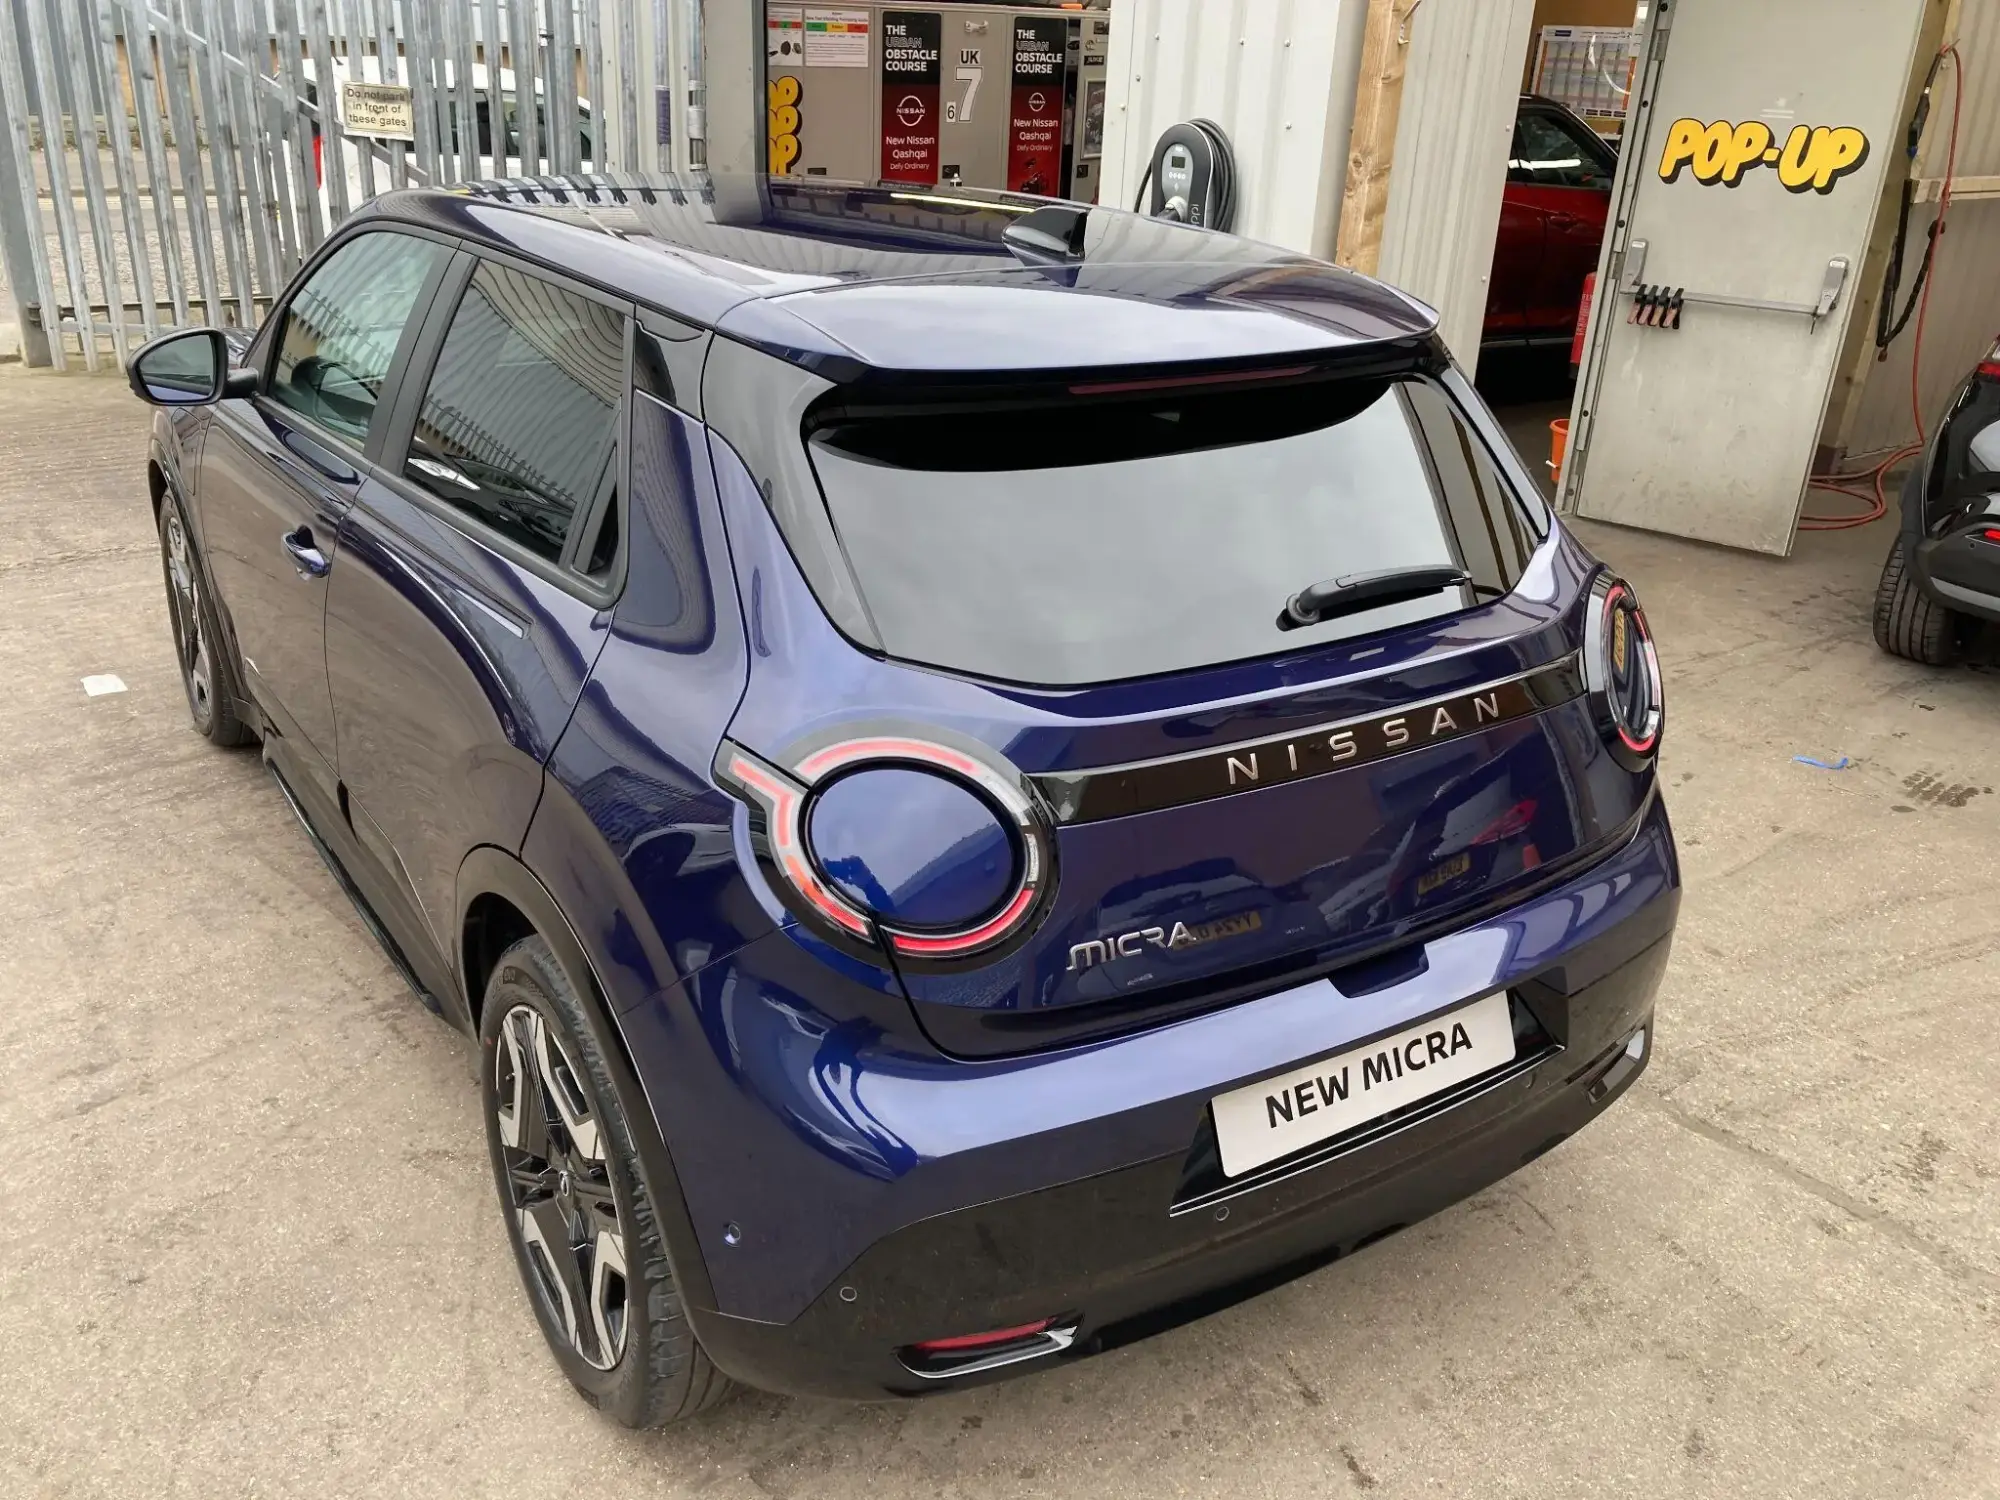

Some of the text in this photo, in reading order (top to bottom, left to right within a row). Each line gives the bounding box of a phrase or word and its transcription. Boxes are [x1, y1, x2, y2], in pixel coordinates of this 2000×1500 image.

[886, 25, 907, 35] THE
[1016, 29, 1035, 39] THE
[885, 36, 922, 48] URBAN
[1016, 41, 1049, 51] URBAN
[886, 49, 938, 60] OBSTACLE
[961, 50, 979, 64] UK
[1015, 52, 1063, 63] OBSTACLE
[885, 61, 927, 72] COURSE
[1015, 63, 1053, 74] COURSE
[347, 88, 361, 98] Do
[364, 91, 380, 100] not
[955, 66, 983, 122] 7
[353, 102, 401, 113] in front of
[947, 105, 955, 120] 6
[349, 114, 407, 127] these gates
[1013, 118, 1059, 128] New Nissan
[885, 135, 935, 145] New Nissan
[1019, 131, 1052, 142] Qashqai
[892, 149, 928, 159] Qashqai
[1657, 118, 1870, 195] POP-UP
[889, 162, 930, 171] Defy Ordinary
[1226, 692, 1500, 785] NISSAN
[1066, 921, 1197, 971] MICRA
[1263, 1021, 1473, 1130] NEW MICRA
